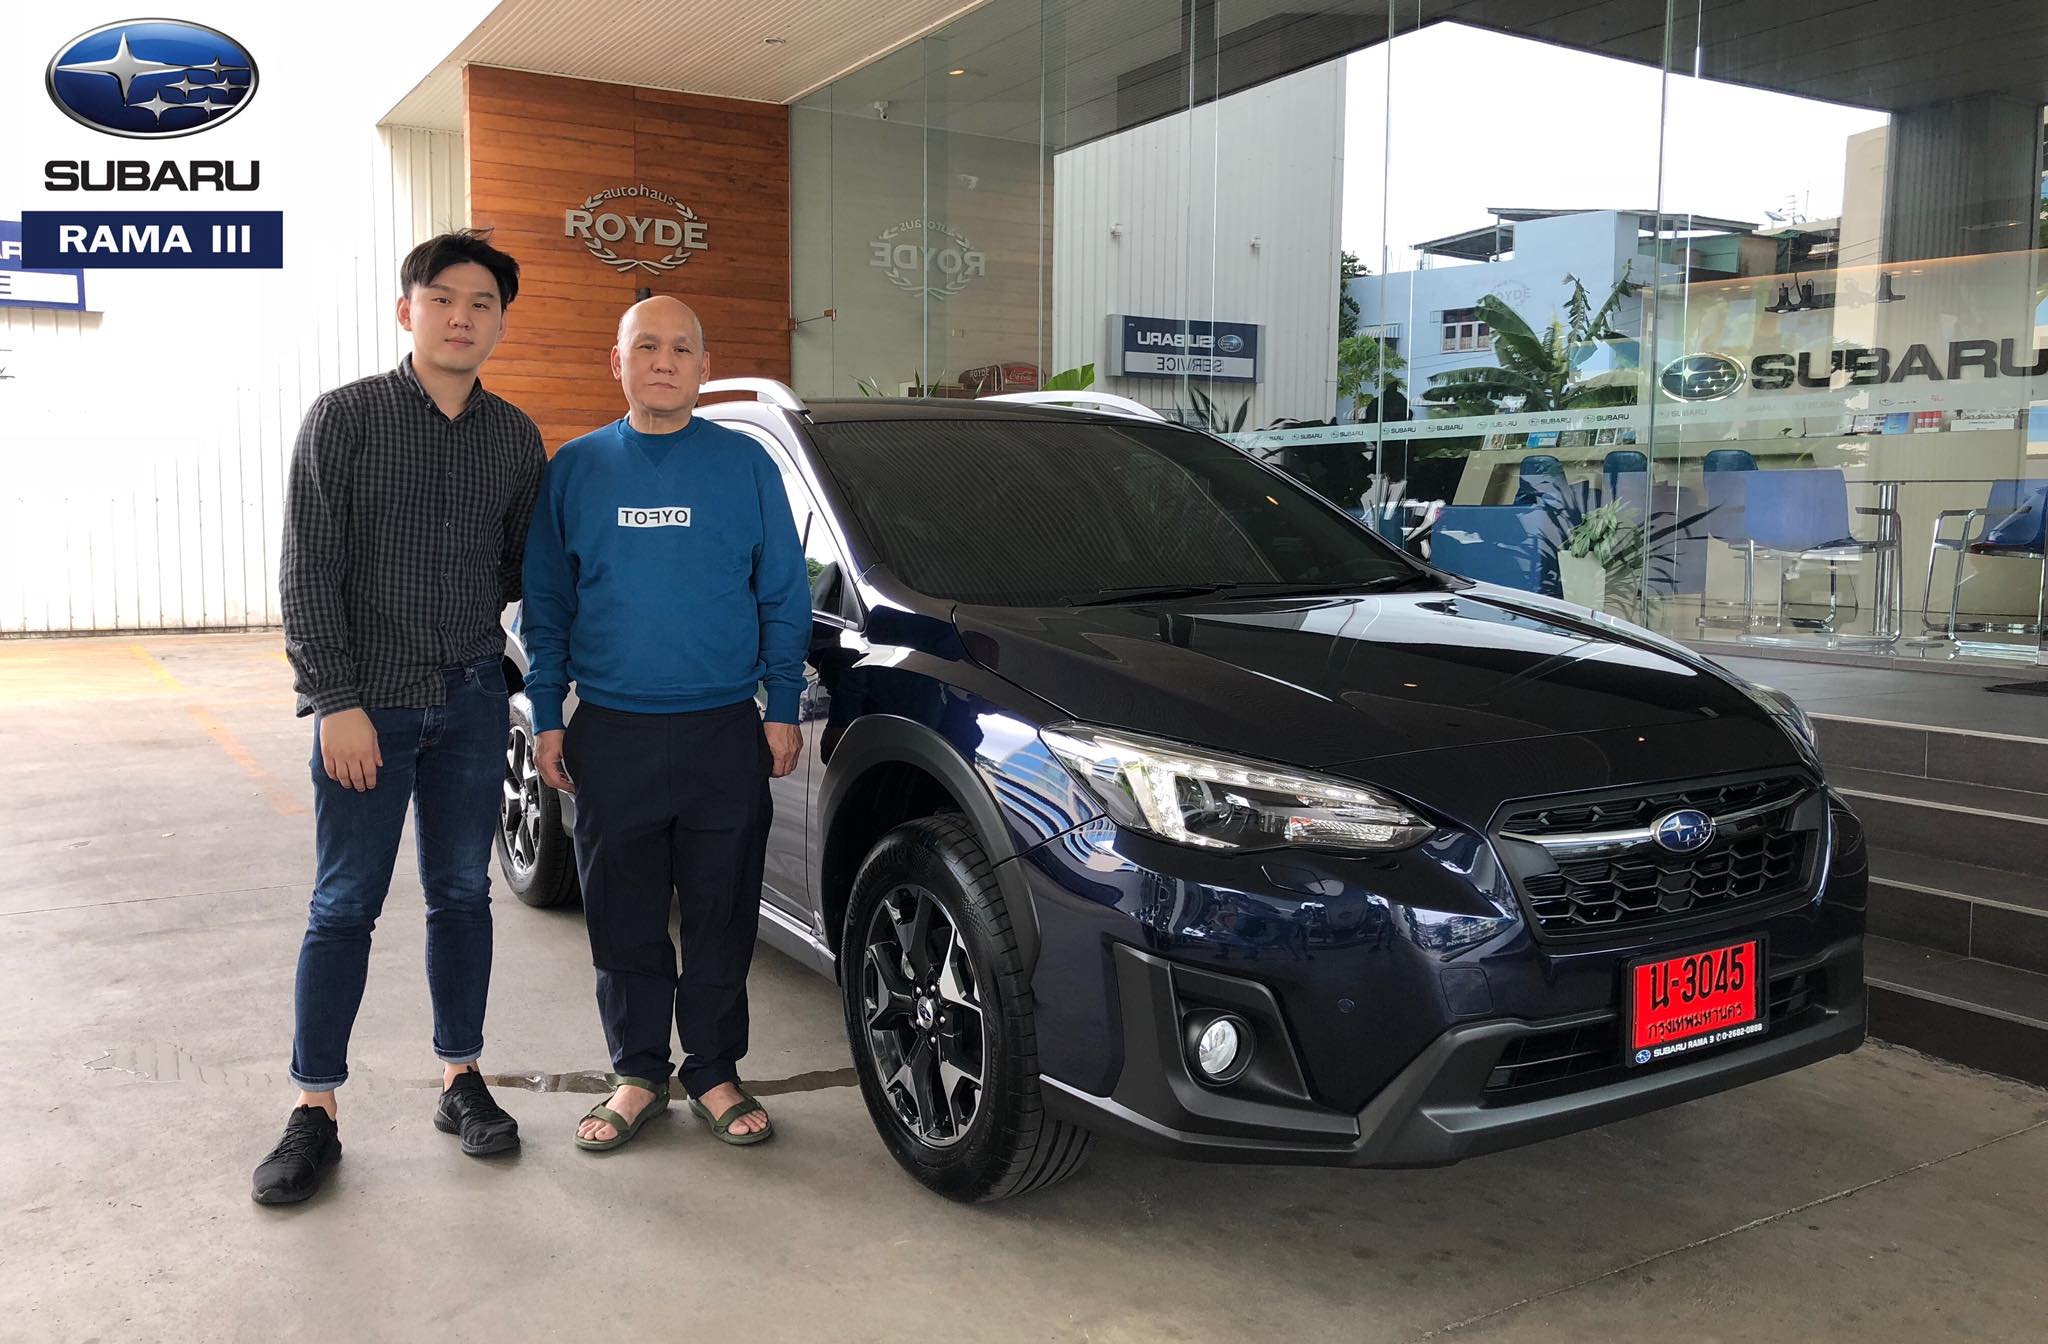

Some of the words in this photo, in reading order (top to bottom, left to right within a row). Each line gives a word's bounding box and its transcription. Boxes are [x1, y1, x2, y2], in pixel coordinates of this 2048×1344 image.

[603, 184, 676, 206] autohaus
[565, 209, 709, 250] ROYDE
[1750, 338, 2048, 391] SUBARU
[1436, 424, 1464, 432] SUBARU
[1596, 413, 1630, 422] SUBARU
[1648, 1003, 1743, 1042] กรุงเทพมหานคร
[1653, 1041, 1687, 1058] SUBARU
[1687, 1037, 1708, 1049] RAMA
[1709, 1036, 1715, 1044] 3
